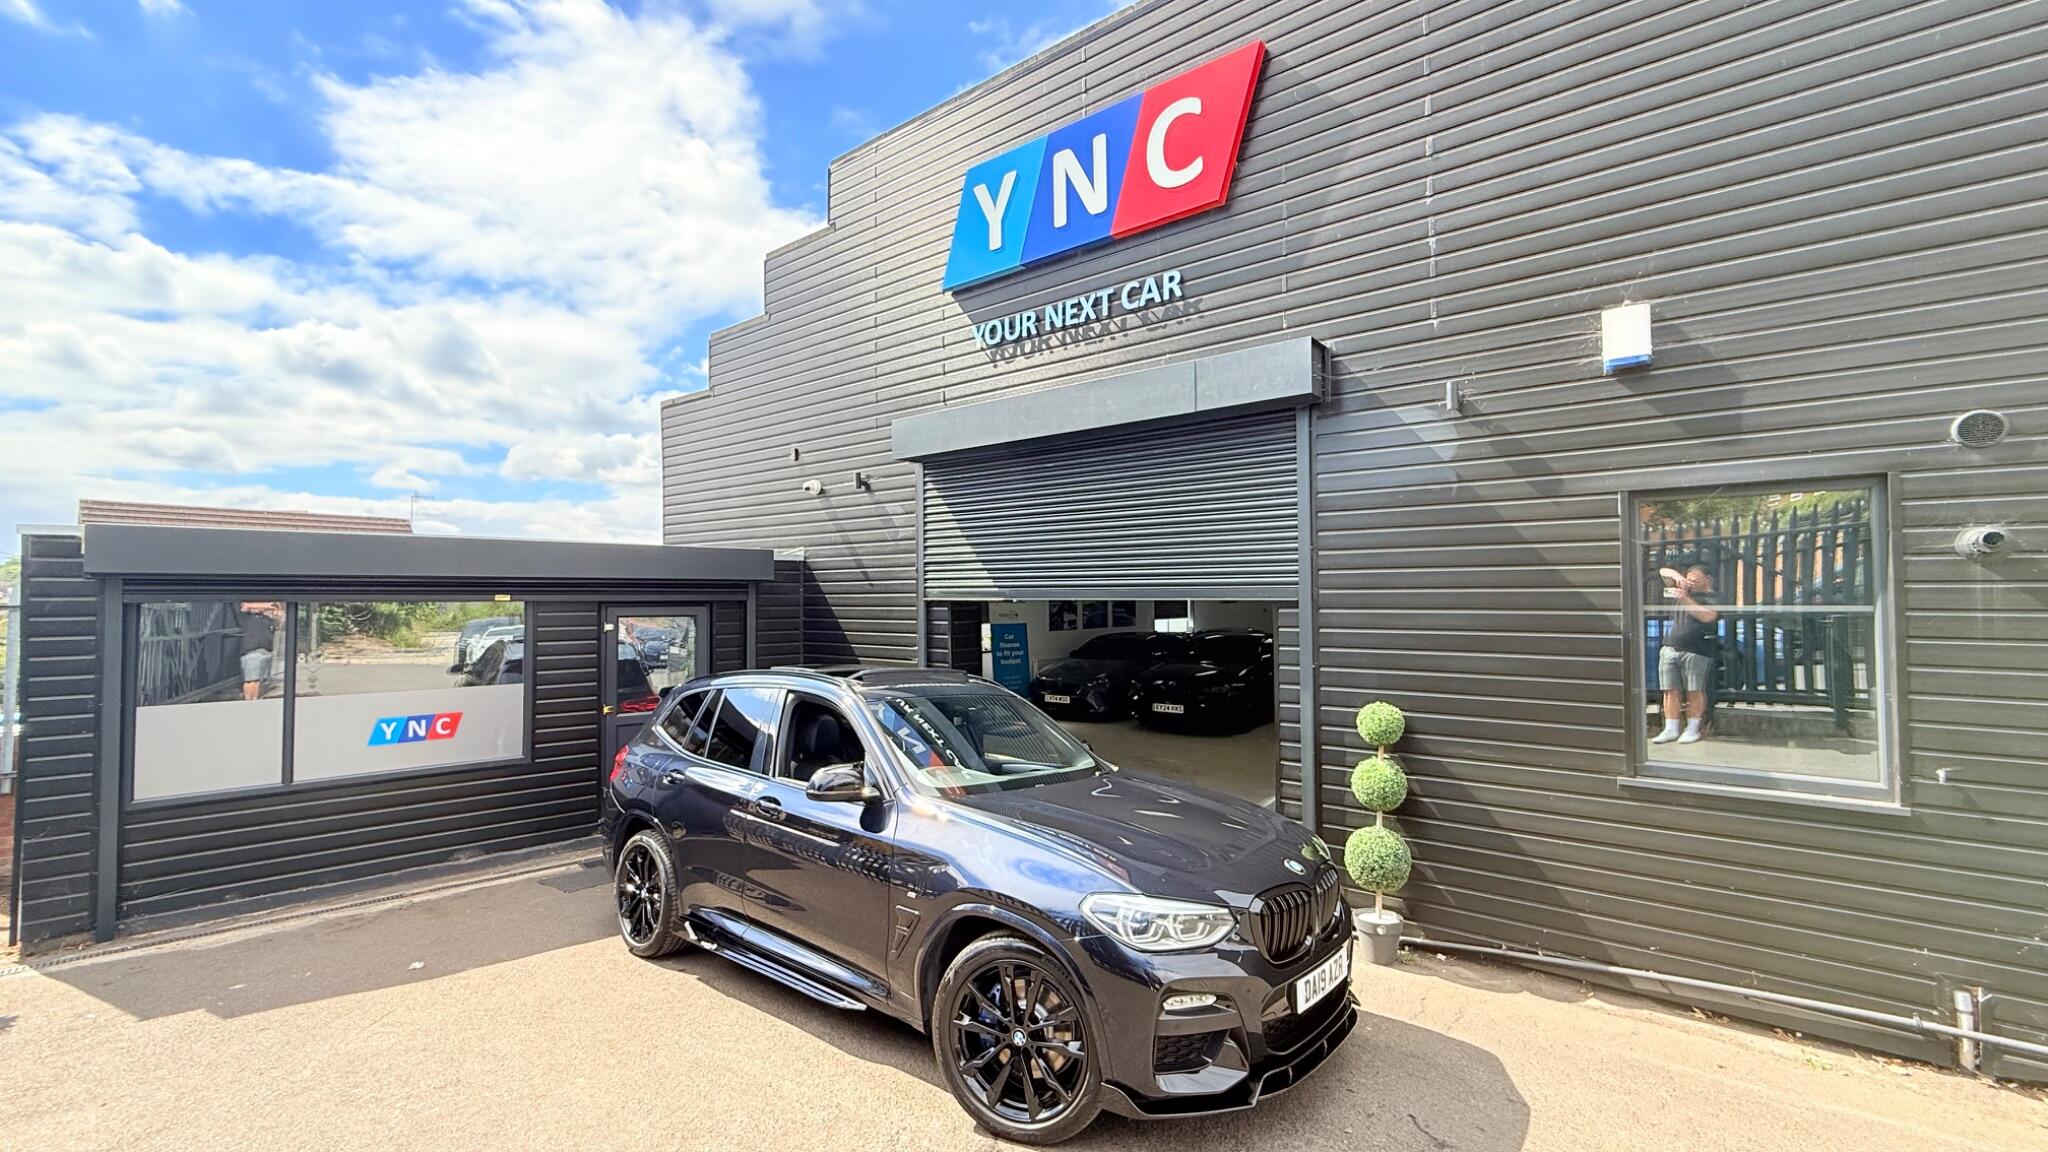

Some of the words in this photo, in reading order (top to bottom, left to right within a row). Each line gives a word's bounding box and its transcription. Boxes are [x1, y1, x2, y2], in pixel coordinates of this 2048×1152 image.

[973, 97, 1204, 251] YNC
[971, 311, 1037, 349] YOUR
[1044, 288, 1114, 328] NEXT
[1120, 269, 1183, 310] CAR
[1011, 650, 1024, 658] your
[379, 716, 452, 741] YNC
[1328, 954, 1344, 987] AZR
